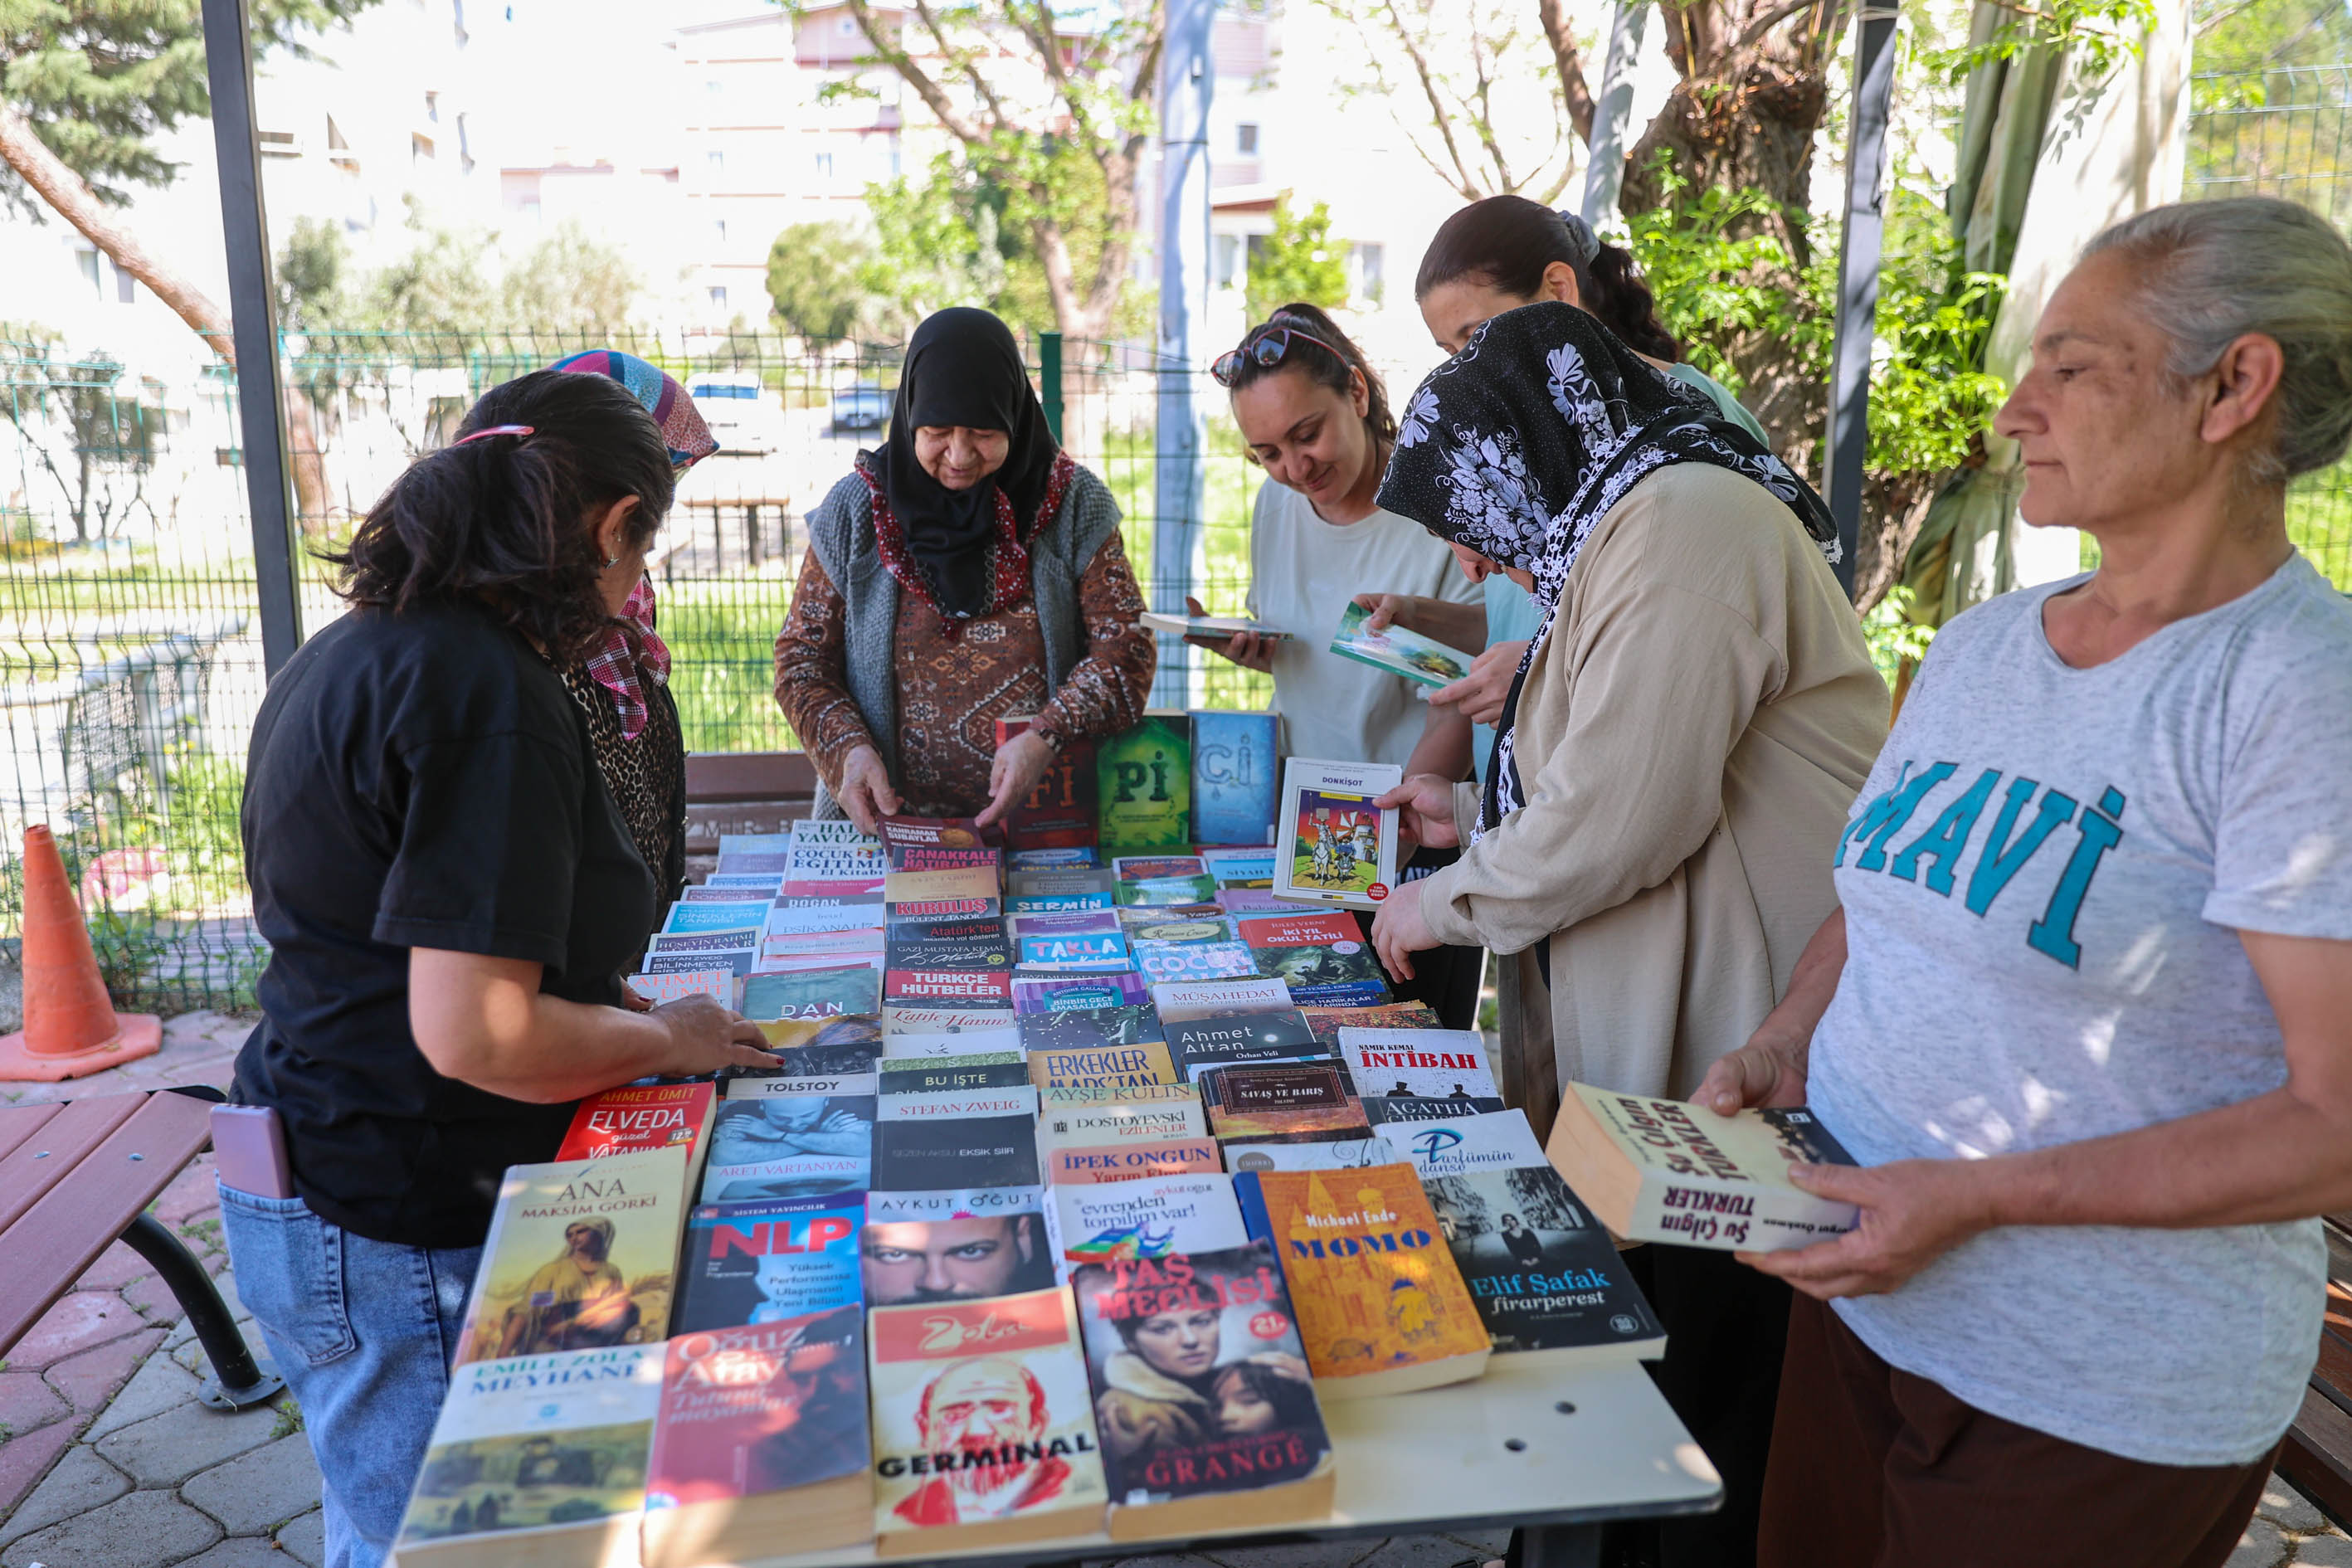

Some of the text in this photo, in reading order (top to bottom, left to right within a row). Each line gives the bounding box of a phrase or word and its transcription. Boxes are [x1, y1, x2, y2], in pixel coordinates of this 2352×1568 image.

[1322, 777, 1363, 786] DONKİŞOT
[885, 825, 937, 836] KAHRAMAN
[888, 832, 940, 843] SUBAYLAR
[1833, 759, 2126, 971] MAVİ
[895, 898, 988, 916] KURULUŞ
[930, 923, 1000, 937] Atatürk'ten
[1266, 932, 1343, 943] OKUL TATİLİ
[1283, 928, 1303, 936] İKİ
[1029, 938, 1118, 958] TAKLA
[652, 959, 734, 970] BİLİNMEYEN
[634, 970, 727, 988] AHMET
[660, 983, 727, 1000] ÜMİT
[901, 984, 1002, 996] HUTBELER
[1172, 988, 1278, 1003] MÜŞAHEDAT
[1055, 1001, 1113, 1011] MASALLARI
[1317, 996, 1372, 1004] HARİKALAR
[780, 1001, 844, 1017] DAN
[891, 1009, 1009, 1029] Latife Hanım
[1181, 1025, 1254, 1044] Ahmet
[1186, 1041, 1245, 1054] Altan
[1234, 1049, 1279, 1060] Orhan Veli
[1358, 1044, 1386, 1052] NAMIK
[1046, 1049, 1151, 1077] ERKEKLER
[1359, 1049, 1479, 1070] İNTİBAH
[764, 1080, 840, 1093] TOLSTOY
[925, 1076, 947, 1086] BU
[599, 1089, 655, 1103] AHMET
[1049, 1088, 1108, 1103] AYŞE
[1239, 1086, 1325, 1100] SAVAŞ VE BARIŞ
[899, 1099, 1020, 1116] STEFAN ZWEIG
[1385, 1101, 1482, 1117] AGATHA
[587, 1108, 685, 1135] ELVEDA
[1118, 1122, 1187, 1136] EZİLENLER
[611, 1129, 652, 1144] güzel
[1410, 1127, 1517, 1165] Parfümün
[1063, 1147, 1211, 1171] İPEK ONGUN
[718, 1160, 858, 1177] ARET VARTANYAN
[556, 1178, 626, 1202] ANA
[521, 1205, 594, 1220] MAKSİM
[769, 1204, 827, 1215] YAYINCILIK
[881, 1199, 954, 1210] AYKUT
[1081, 1195, 1166, 1216] evrenden
[1082, 1203, 1196, 1231] torpilim var!
[1305, 1209, 1397, 1228] Michael Ende
[1660, 1212, 1751, 1244] Şu Çılgın
[709, 1216, 853, 1259] NLP
[1289, 1229, 1433, 1260] MOMO
[788, 1261, 835, 1273] Yüksek
[1470, 1268, 1613, 1298] Elif Şafak
[774, 1298, 804, 1308] Yeni
[1492, 1289, 1606, 1316] firarperest
[677, 1326, 807, 1361] Oğuz
[571, 1350, 645, 1367] ZOLA
